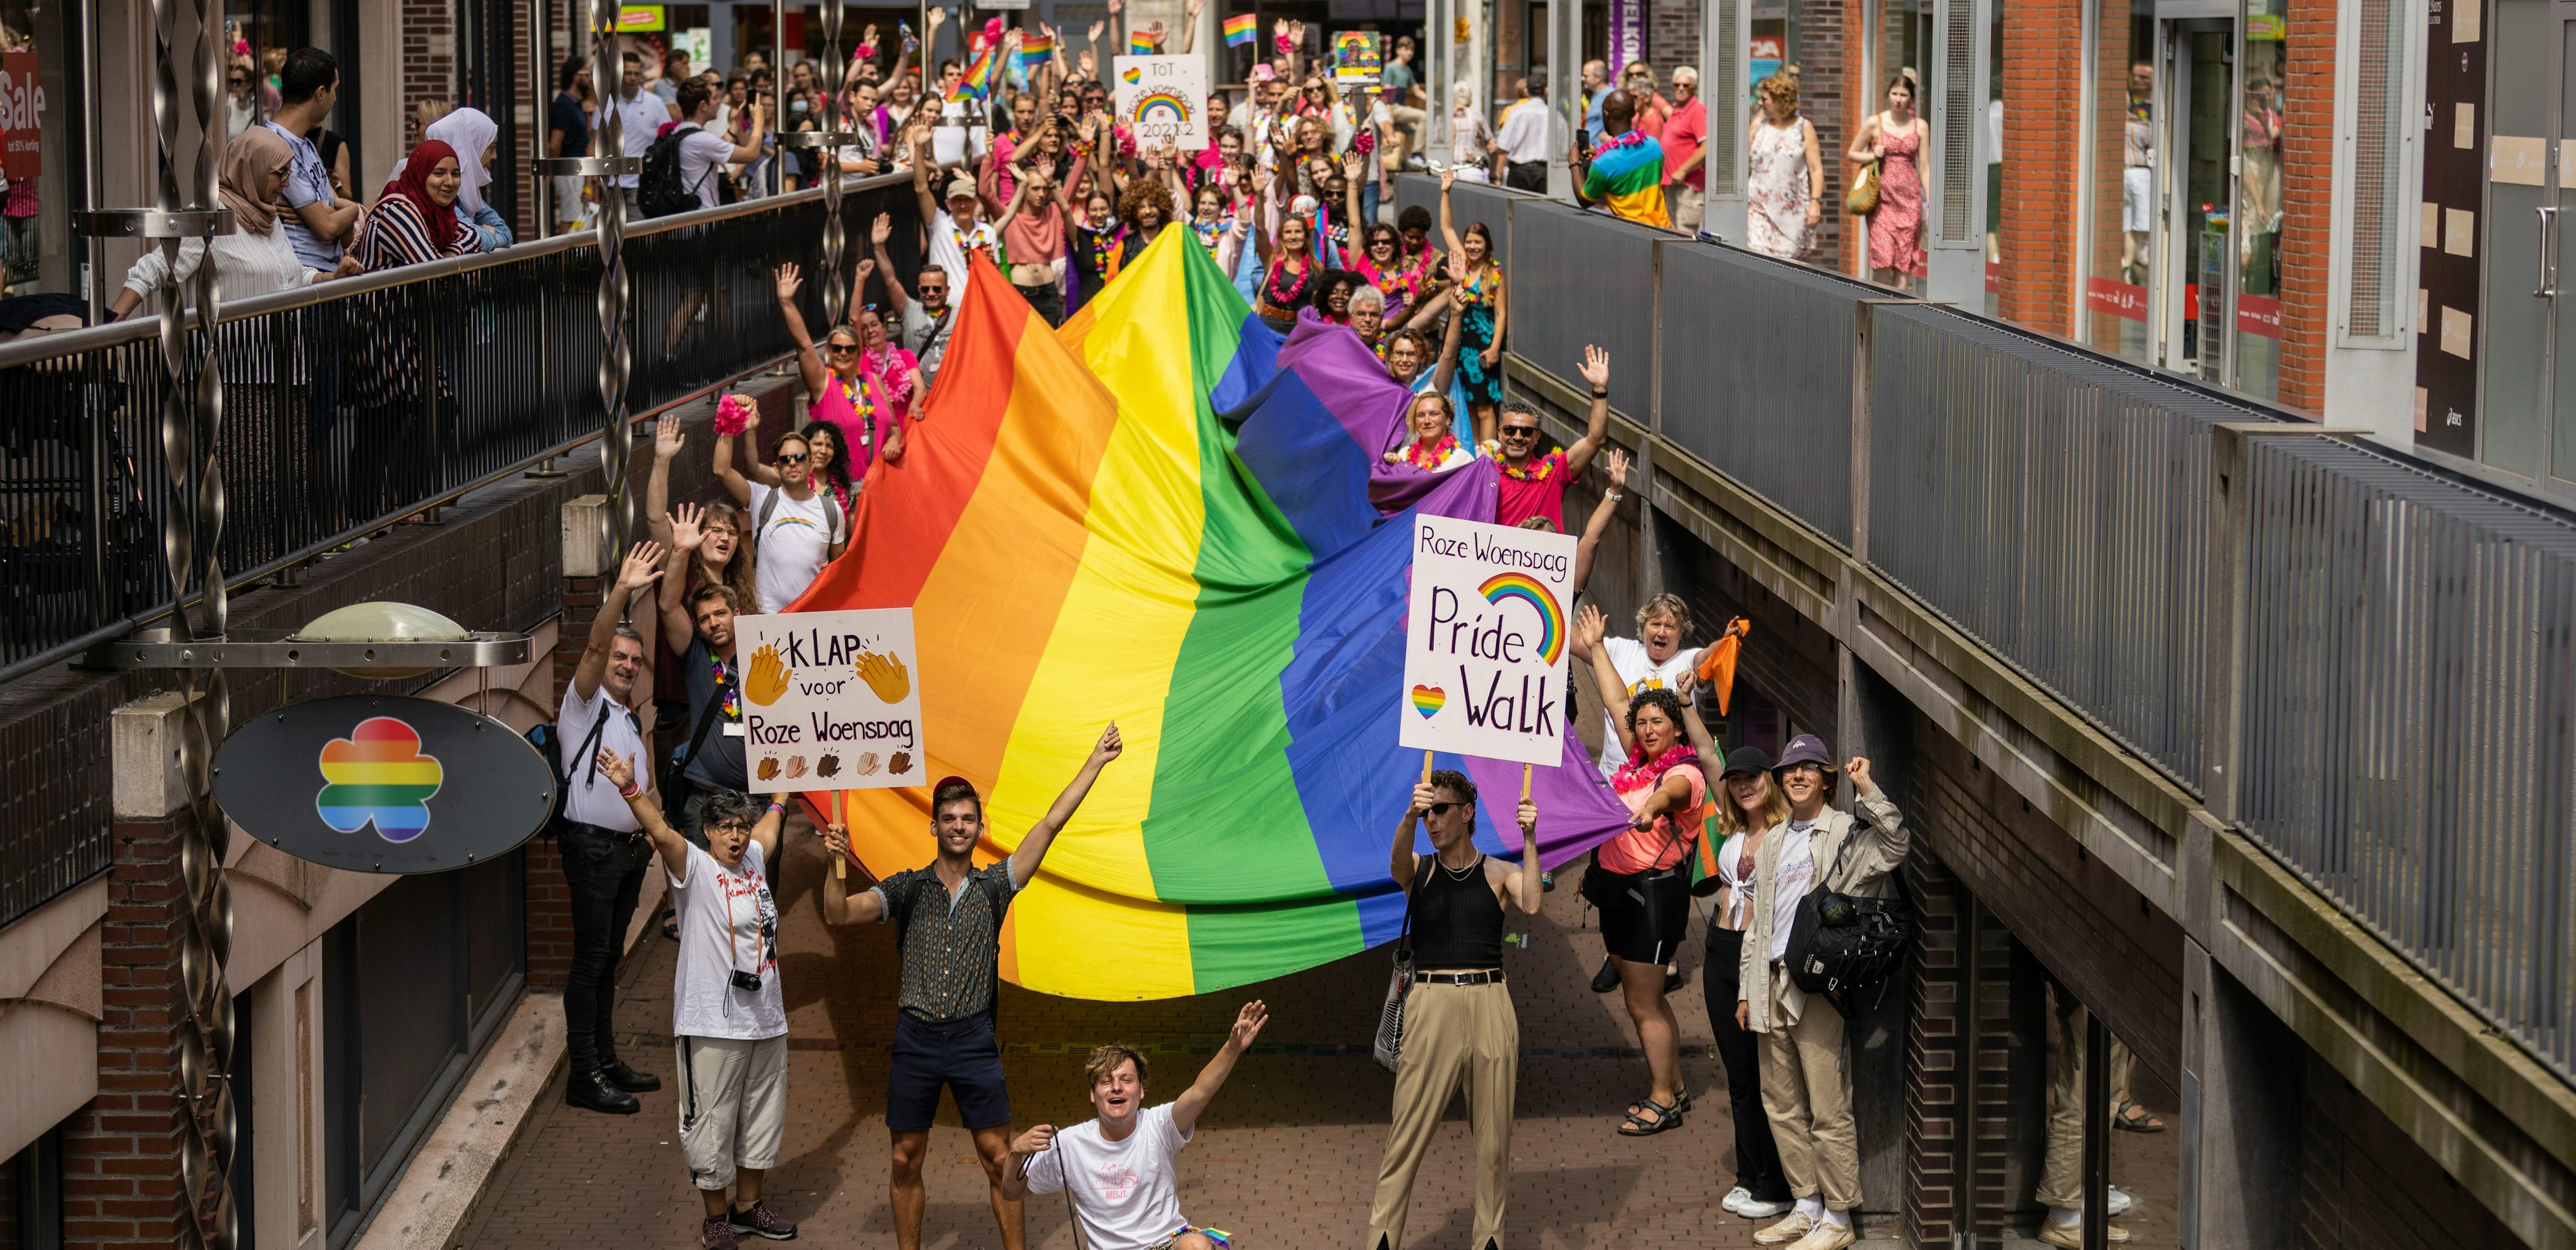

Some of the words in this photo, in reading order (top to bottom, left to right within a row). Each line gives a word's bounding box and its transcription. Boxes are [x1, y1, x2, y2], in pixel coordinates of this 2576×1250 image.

[0, 70, 46, 131] Sale
[1421, 525, 1468, 559] Roze
[1428, 585, 1525, 663] Pride
[788, 628, 861, 668] KLAP
[800, 680, 846, 696] voor
[748, 714, 801, 746] Roze
[1106, 1190, 1128, 1199] MEIJT.
